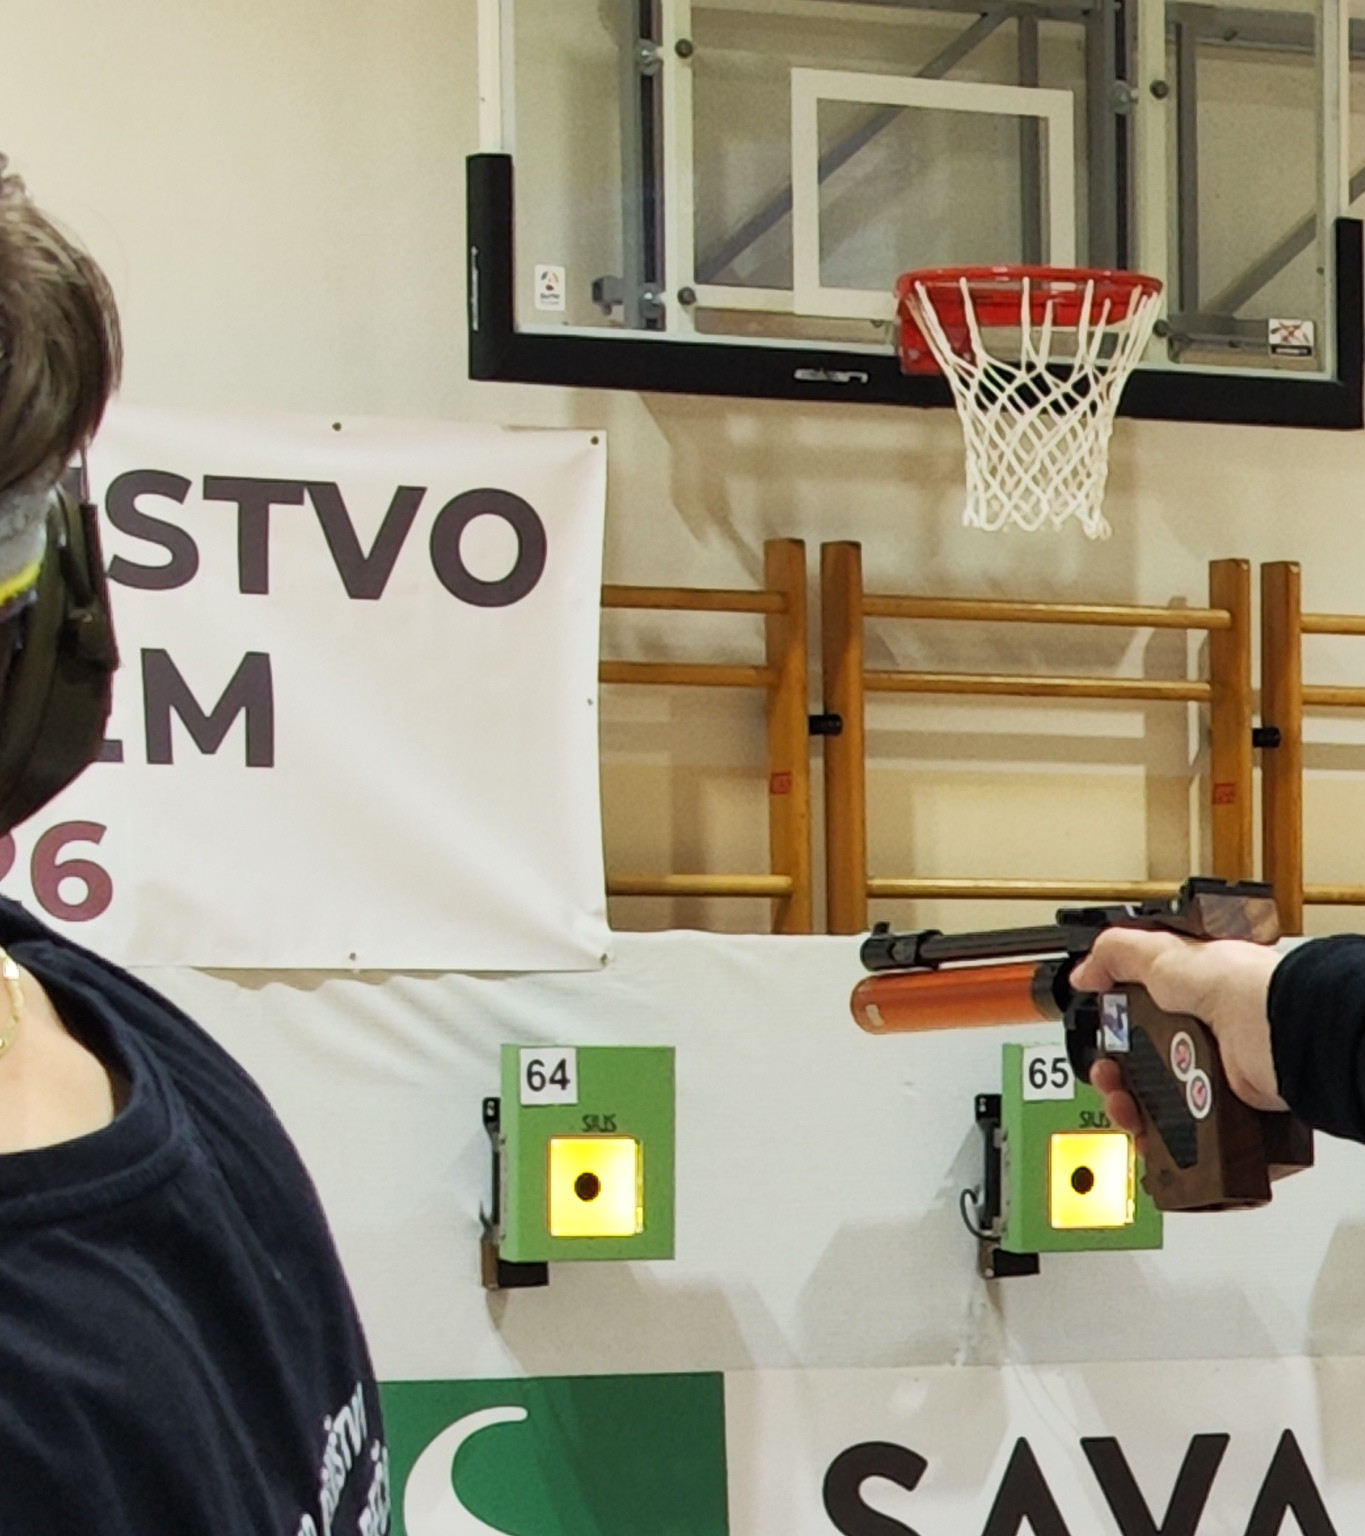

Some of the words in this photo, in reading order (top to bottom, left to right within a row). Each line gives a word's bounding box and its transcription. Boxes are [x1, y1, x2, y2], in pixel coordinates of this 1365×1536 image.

[72, 467, 548, 608] STVO
[100, 647, 274, 768] M
[525, 1058, 571, 1092] 64
[1028, 1057, 1069, 1090] 65
